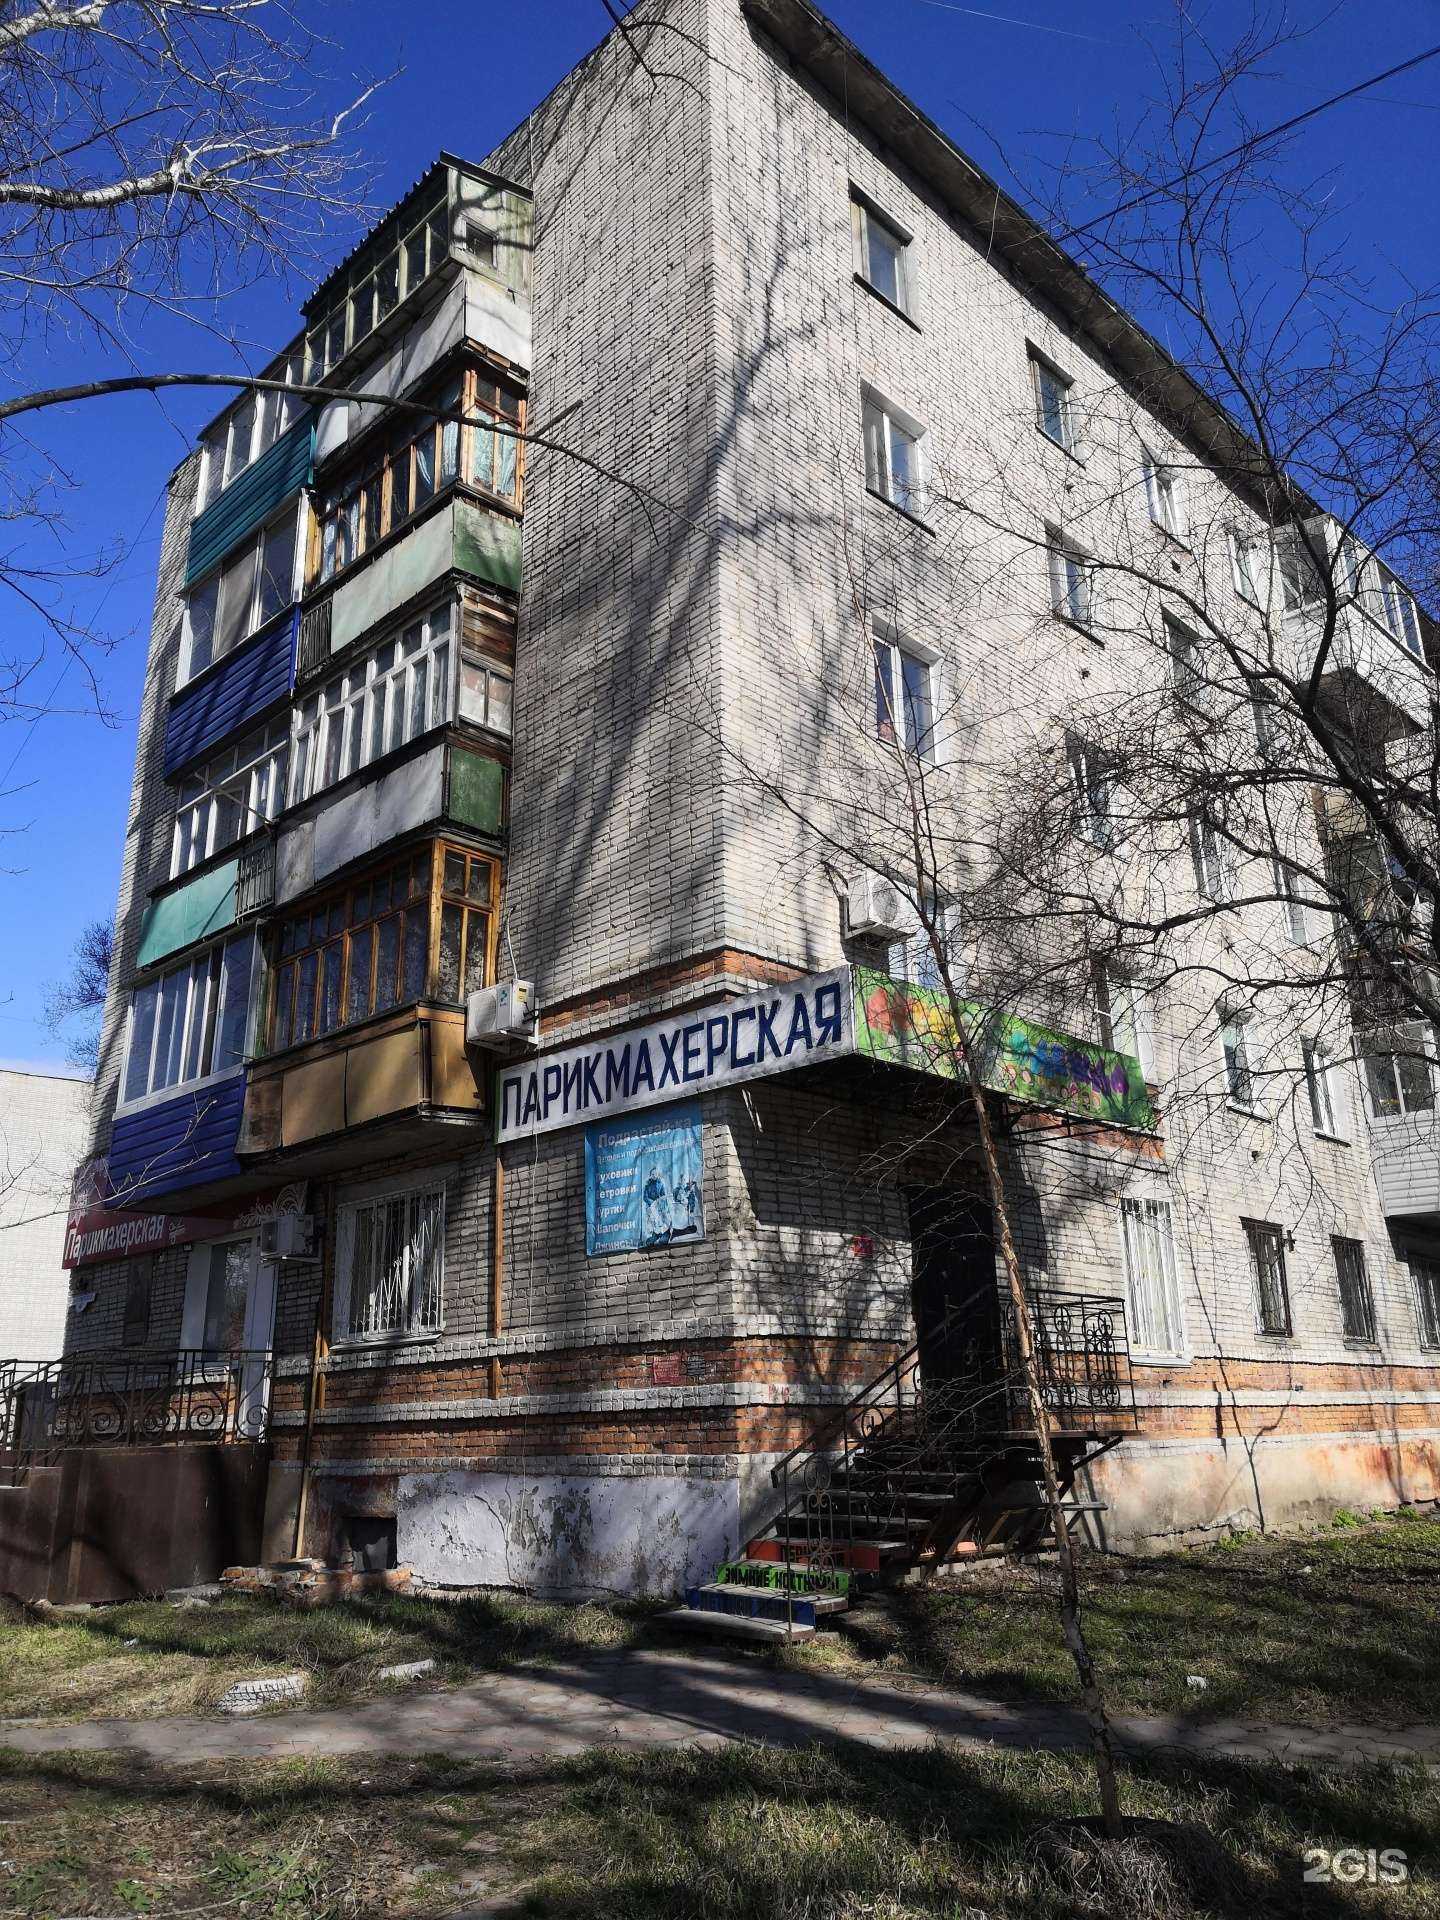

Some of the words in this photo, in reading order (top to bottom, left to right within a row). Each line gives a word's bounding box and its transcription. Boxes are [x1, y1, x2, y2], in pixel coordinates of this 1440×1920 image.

[502, 981, 841, 1130] ПАРИКМАХЕРСКАЯ
[596, 1167, 638, 1184] уховики
[596, 1184, 637, 1199] етровки
[64, 1214, 167, 1266] Парикмахерская
